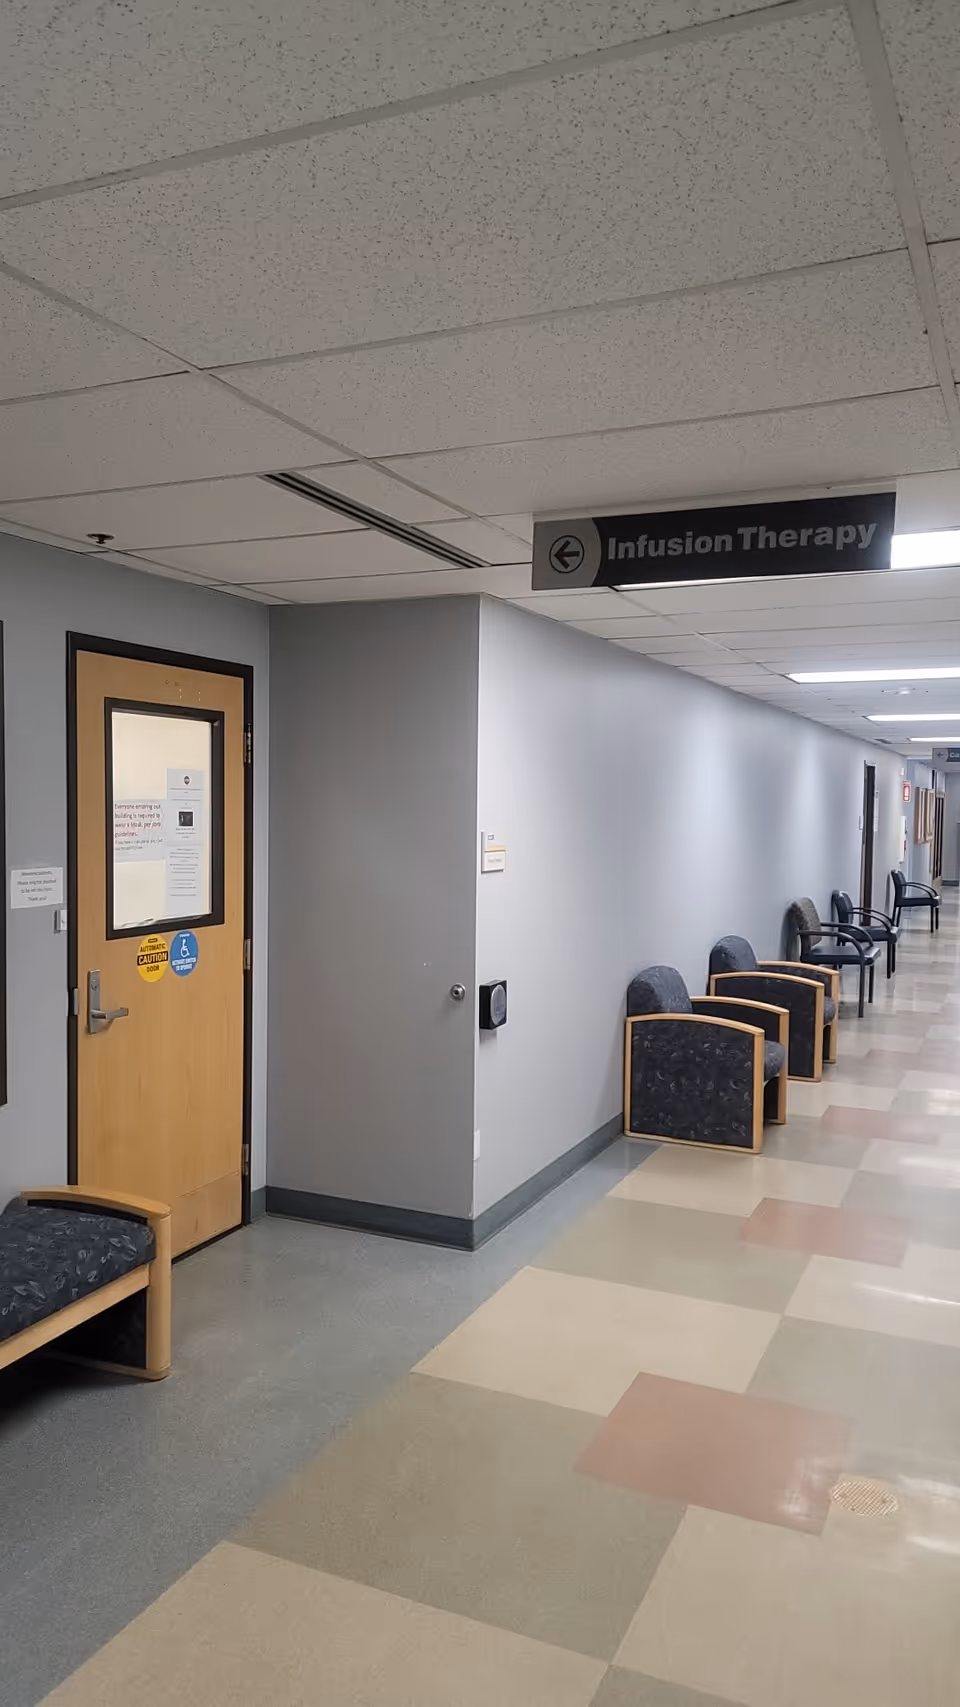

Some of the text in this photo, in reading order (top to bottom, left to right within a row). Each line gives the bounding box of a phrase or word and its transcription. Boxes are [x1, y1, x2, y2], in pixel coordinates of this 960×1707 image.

[608, 523, 877, 560] Infusion Therapy
[140, 943, 166, 952] AUTOMATIC
[138, 952, 167, 965] CAUTION
